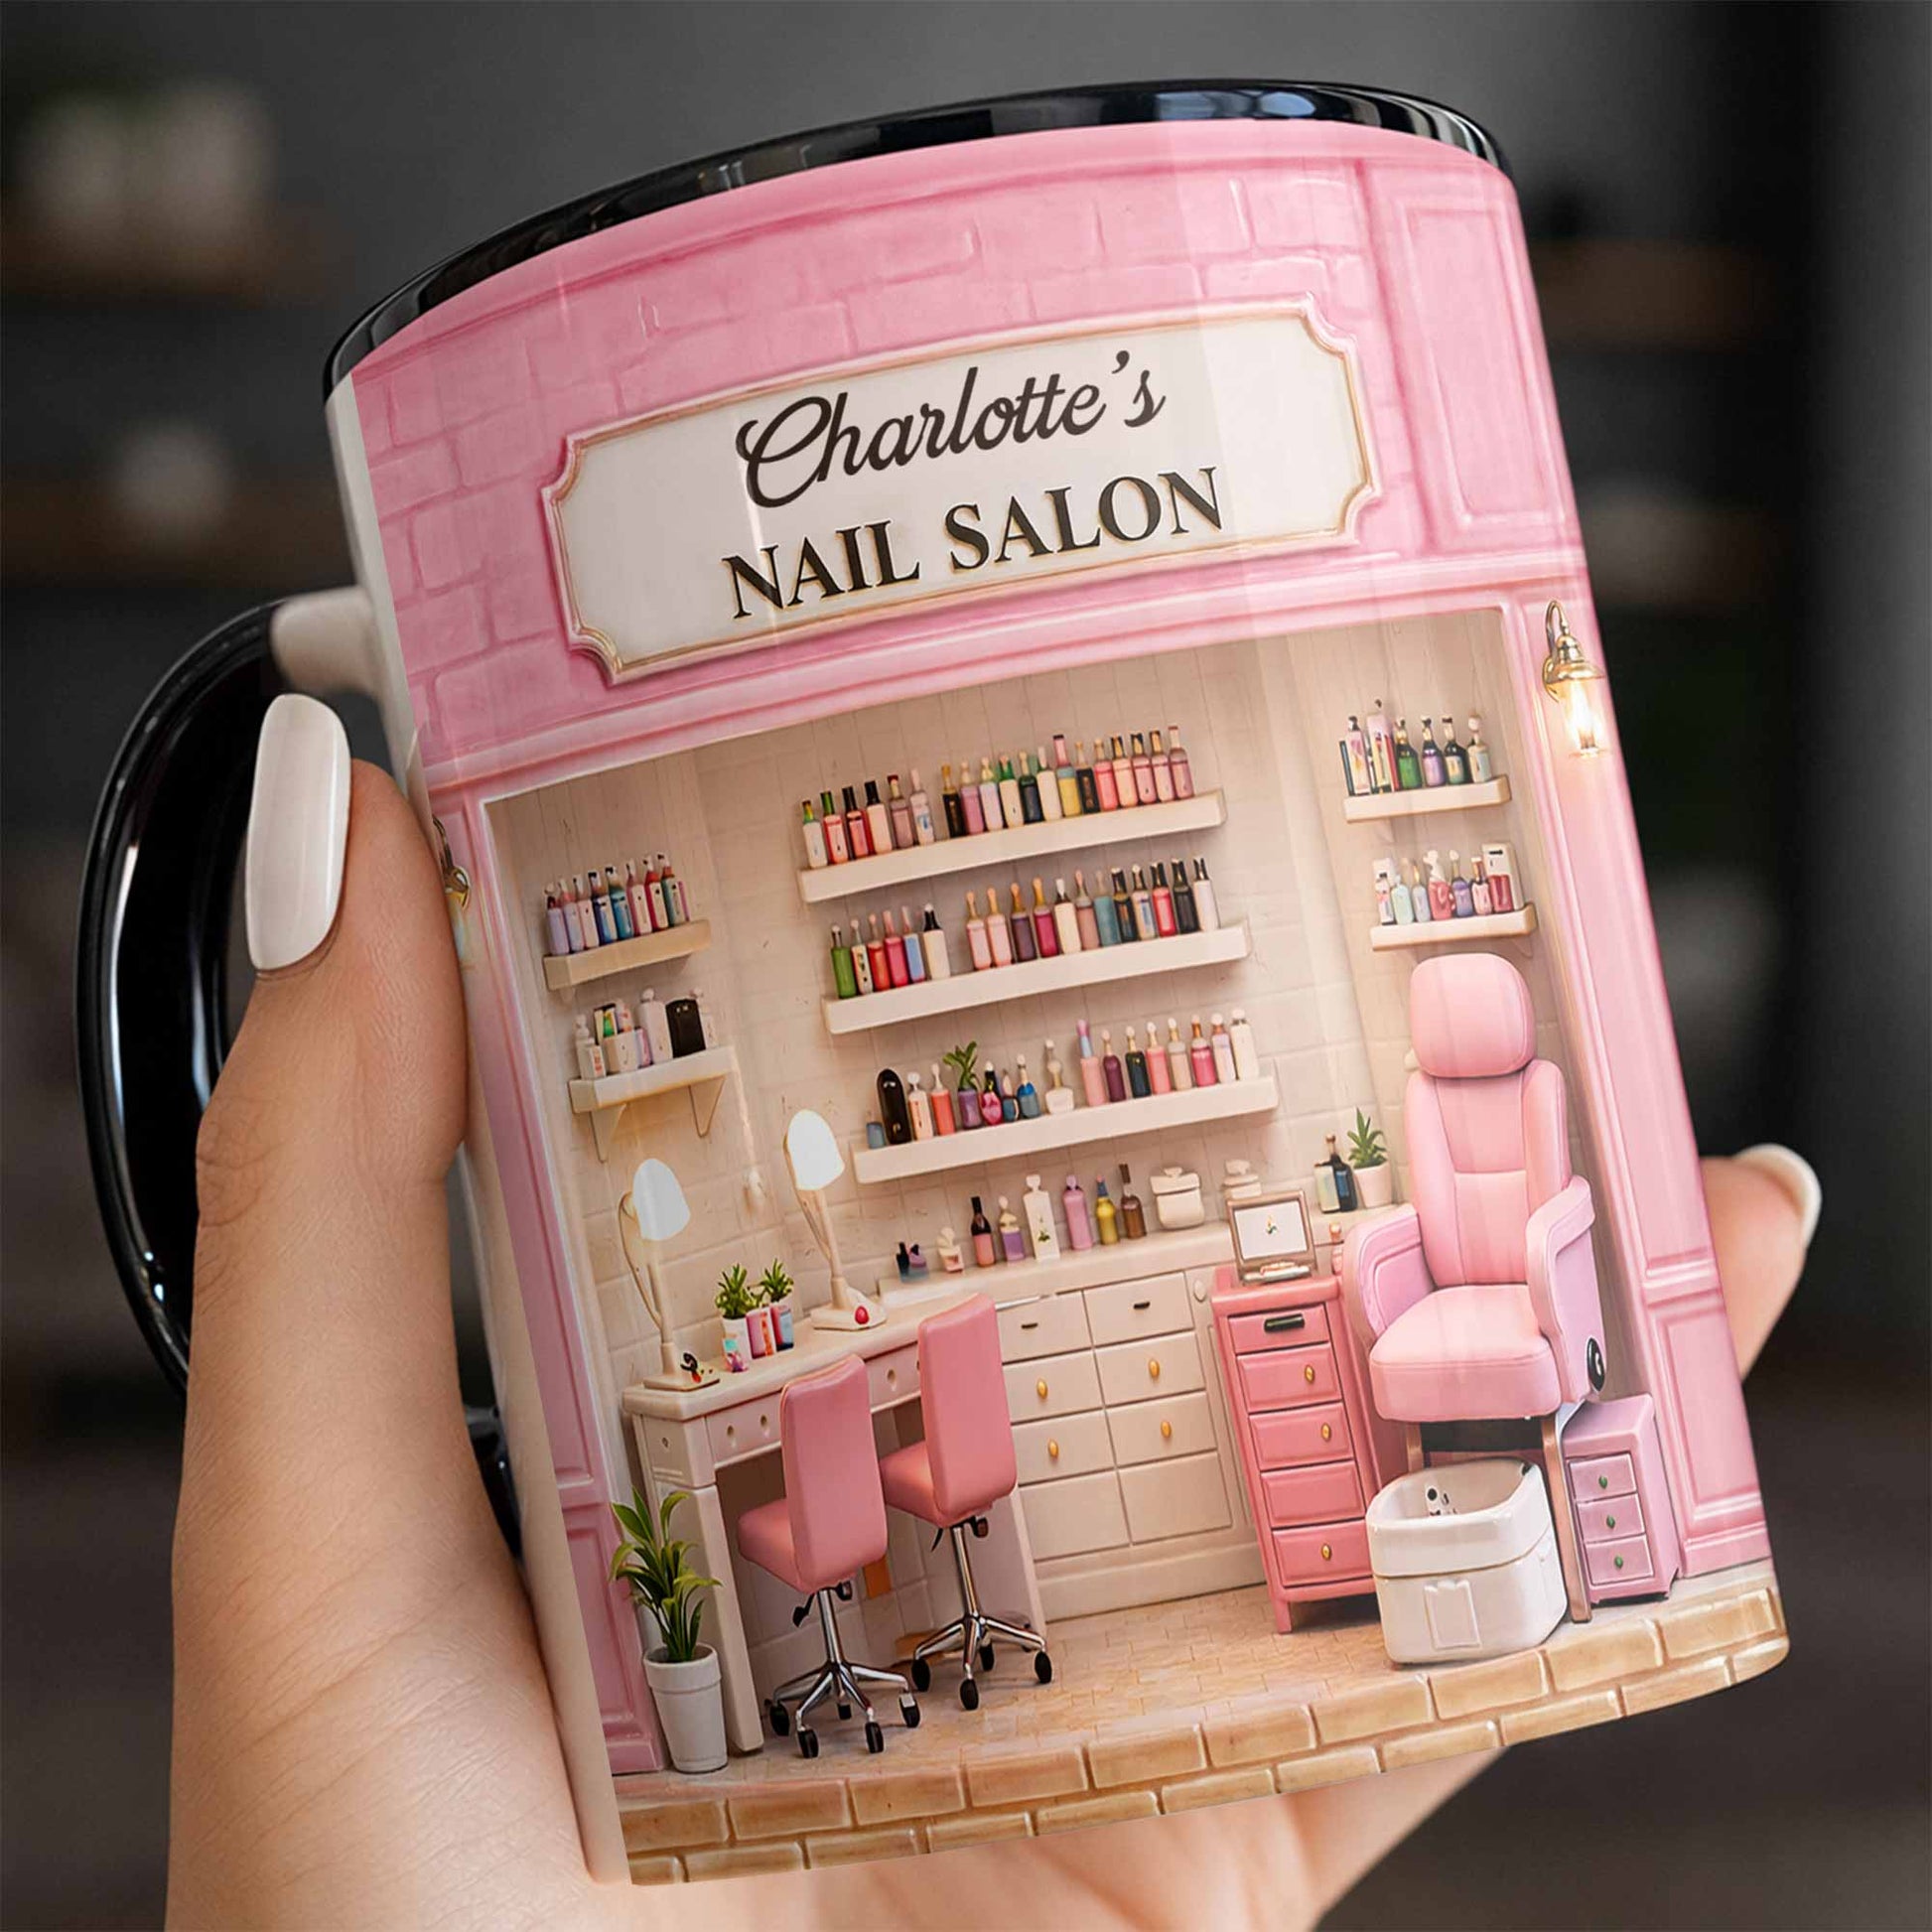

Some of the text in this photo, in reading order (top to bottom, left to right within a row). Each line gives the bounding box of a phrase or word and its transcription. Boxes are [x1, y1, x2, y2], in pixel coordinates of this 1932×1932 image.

[735, 350, 1167, 508] Charlotte's
[721, 467, 1224, 620] NAIL SALON
